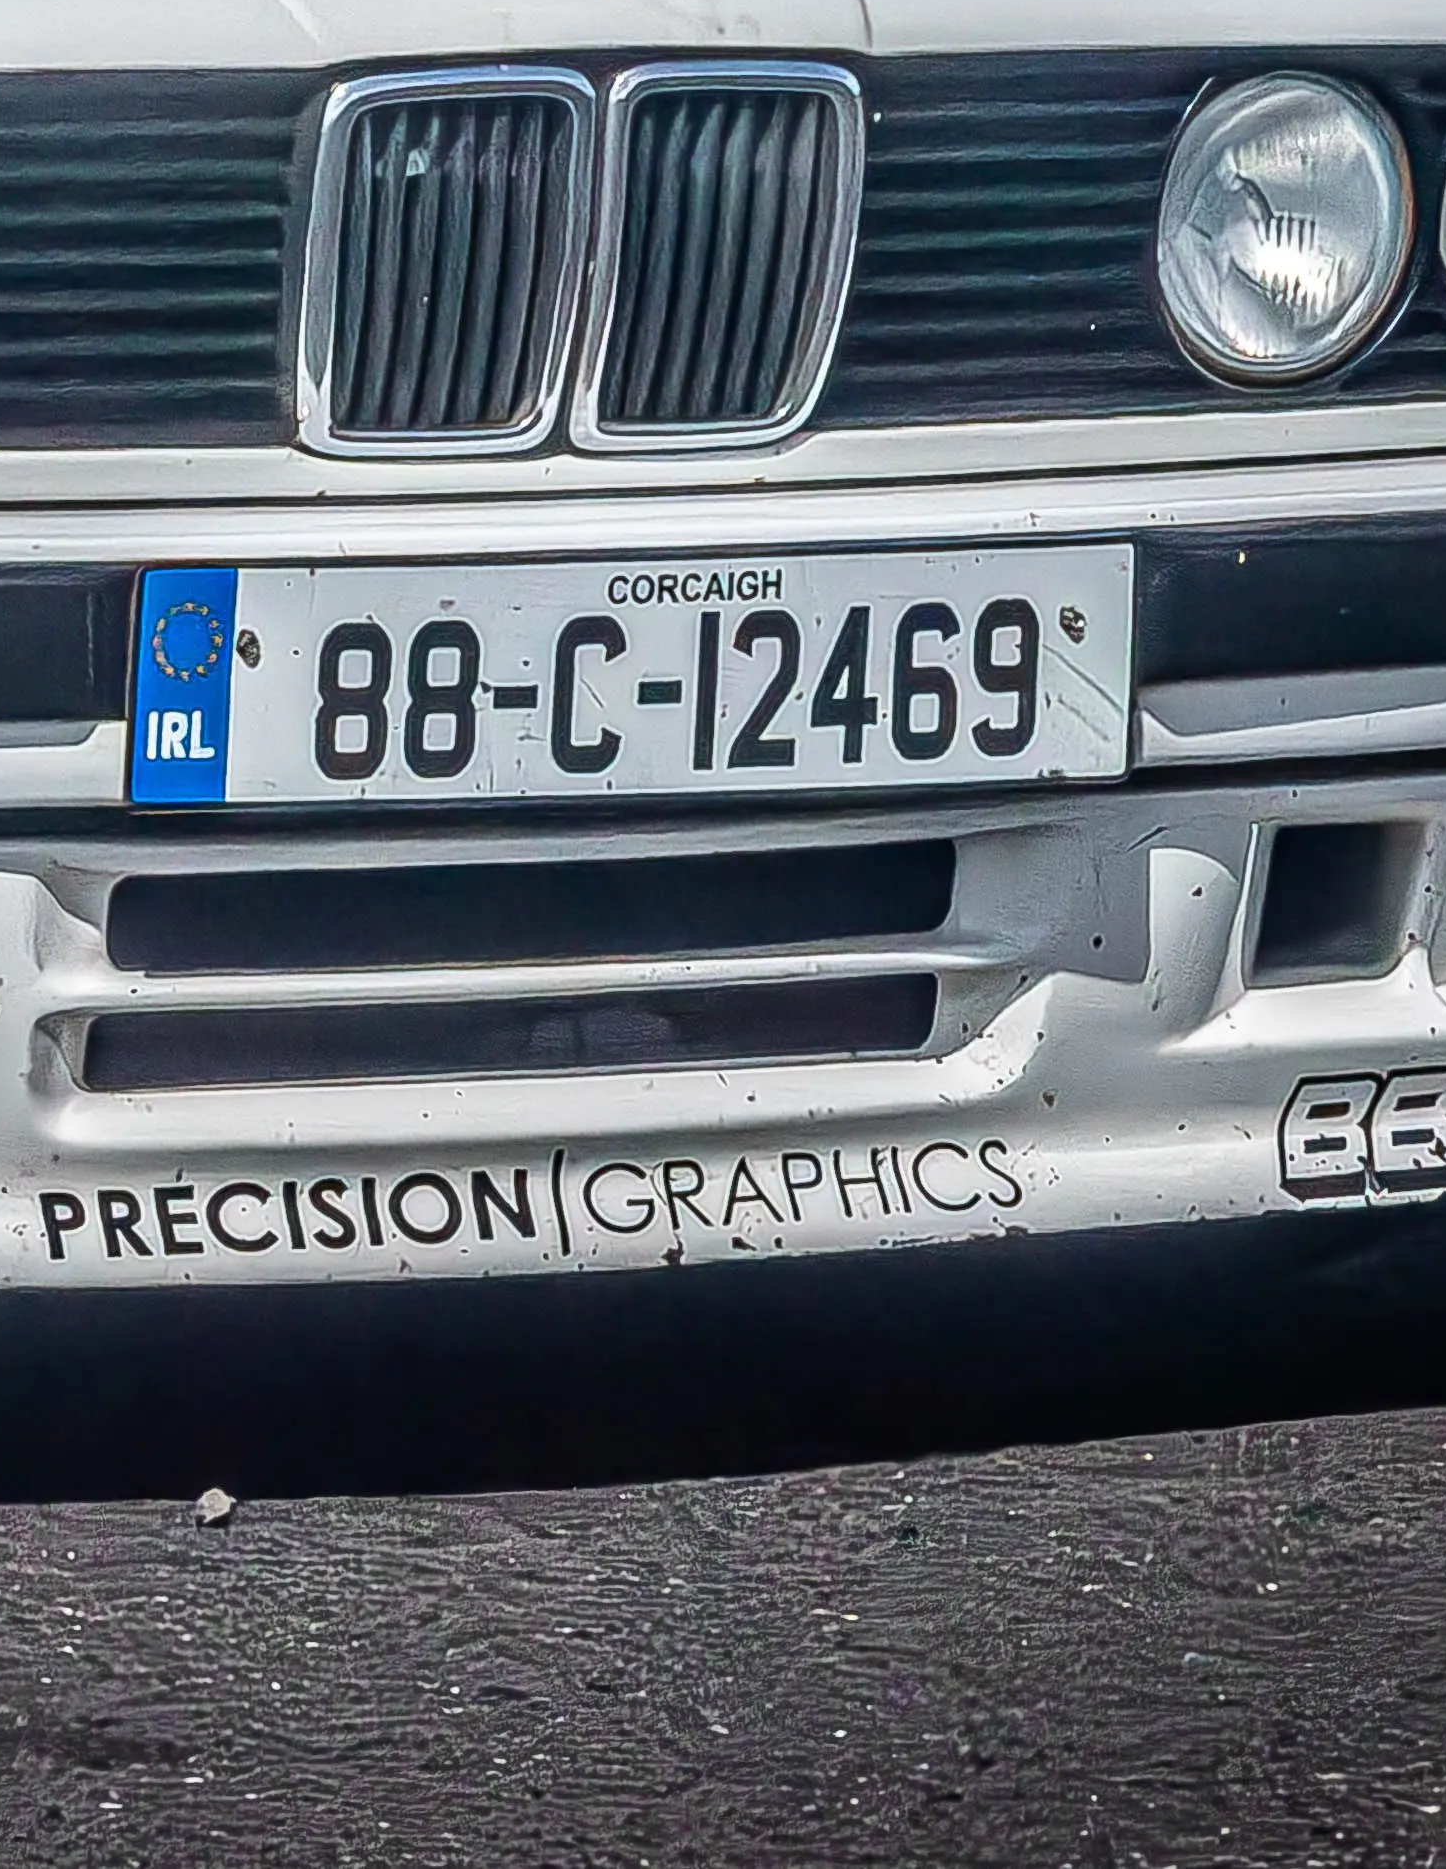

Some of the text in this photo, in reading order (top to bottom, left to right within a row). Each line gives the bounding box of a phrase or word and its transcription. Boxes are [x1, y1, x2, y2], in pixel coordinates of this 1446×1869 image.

[607, 570, 784, 605] CORCAIGH
[314, 597, 1041, 781] 88-C-12469
[146, 709, 216, 762] IRL
[582, 1139, 1023, 1233] GRAPHICS
